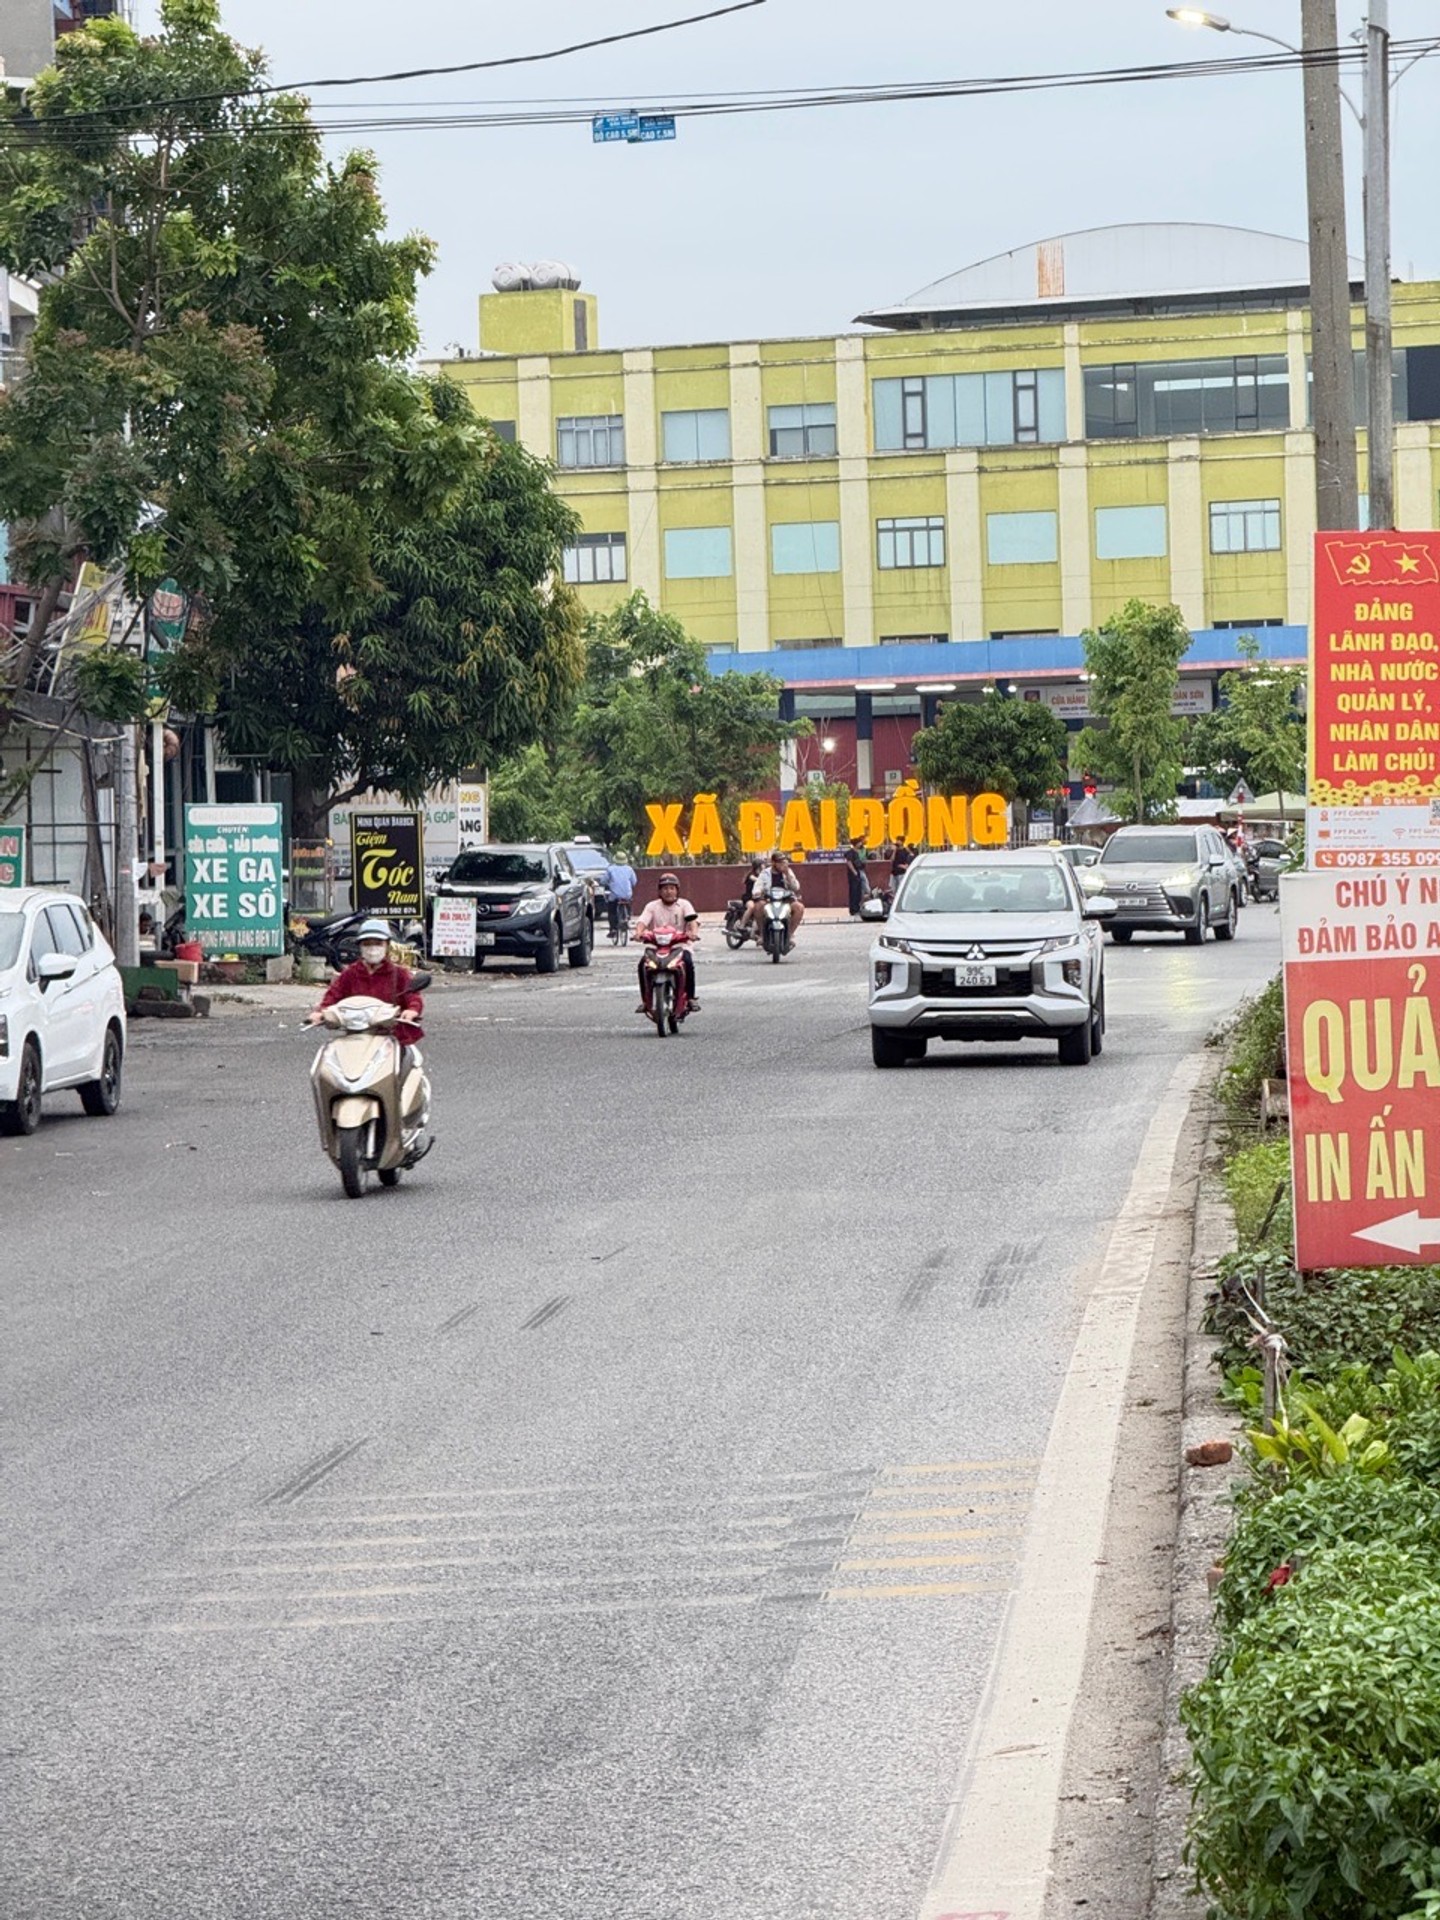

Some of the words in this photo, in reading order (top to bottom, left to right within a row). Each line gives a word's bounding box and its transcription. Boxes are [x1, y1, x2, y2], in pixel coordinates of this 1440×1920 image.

[1354, 598, 1413, 622] ĐẢNG
[1329, 630, 1385, 652] LÃNH
[1391, 633, 1439, 656] ĐẠO,
[1330, 660, 1377, 682] NHÀ
[1380, 659, 1439, 682] NƯỚC
[1337, 687, 1395, 712] QUẢN
[1401, 689, 1432, 713] LÝ,
[1329, 719, 1390, 743] NHÂN
[1395, 719, 1440, 741] DÂN
[1333, 749, 1378, 771] LÀM
[1384, 747, 1435, 771] CHỦ!
[433, 808, 456, 823] GÓP
[645, 792, 727, 856] XÃ
[738, 798, 837, 863] ĐẠI
[848, 778, 1008, 850] ĐỒNG
[192, 858, 228, 883] XE
[238, 857, 276, 883] GA
[361, 848, 415, 889] Tóc
[1337, 852, 1376, 866] 0987
[1381, 851, 1411, 865] 355
[192, 893, 228, 918] XE
[238, 883, 277, 918] SỐ
[387, 890, 419, 905] Nam
[1335, 873, 1387, 909] CHÚ
[1396, 871, 1411, 905] Ý
[1298, 916, 1357, 954] ĐẢM
[1366, 914, 1418, 951] BẢO
[966, 966, 984, 975] 99C
[1305, 1132, 1351, 1203] IN
[1366, 1105, 1426, 1200] ẤN
